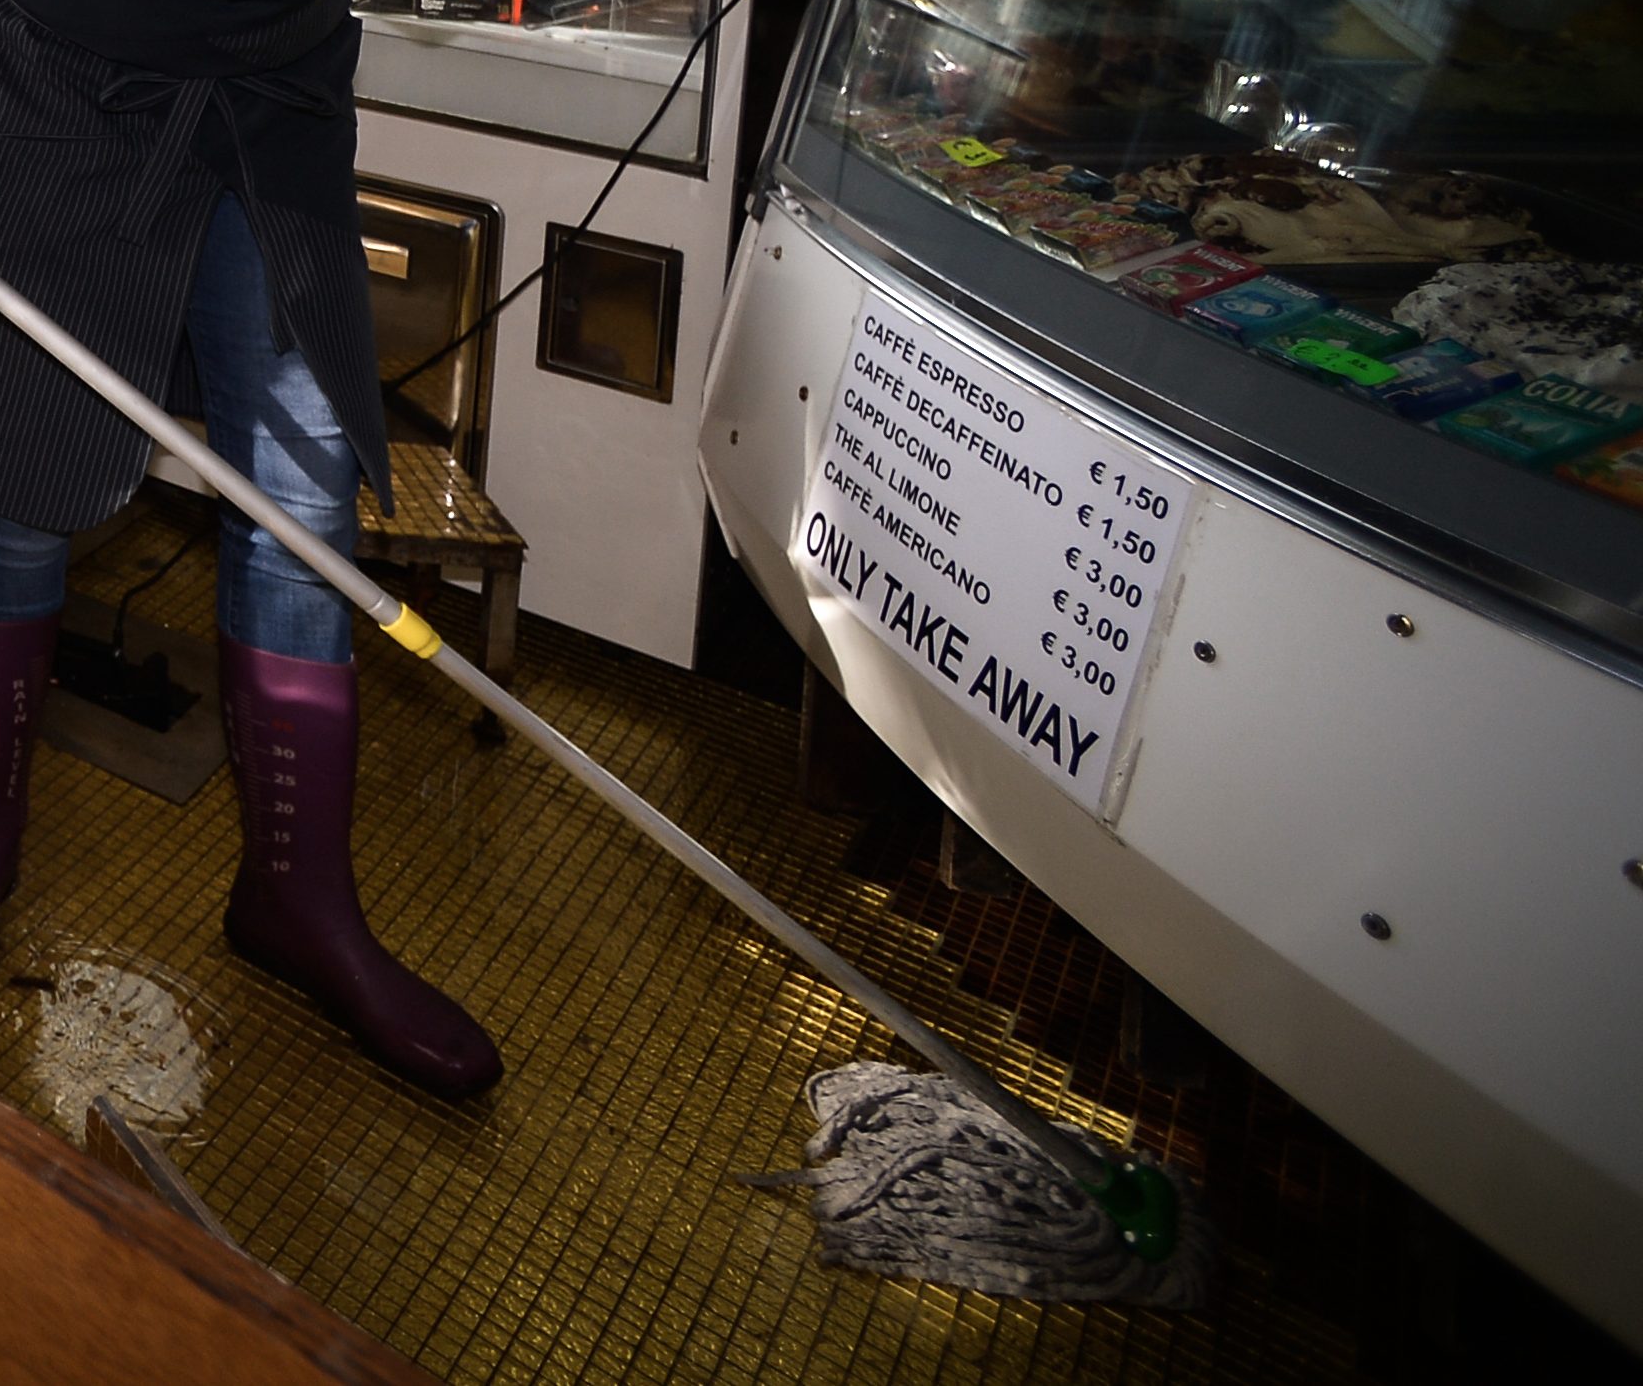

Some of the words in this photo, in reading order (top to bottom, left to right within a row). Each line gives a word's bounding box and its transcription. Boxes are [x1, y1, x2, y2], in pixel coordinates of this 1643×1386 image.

[854, 352, 904, 401] CAFFÈ
[906, 389, 1064, 507] DECAFFEINATO
[1077, 503, 1094, 527] €
[1101, 518, 1156, 565] 1,50
[864, 315, 916, 364] CAFFÈ
[917, 352, 1025, 434] ESPRESSO
[1089, 460, 1106, 484] €
[1113, 473, 1170, 520] 1,50
[833, 422, 862, 461] THE
[862, 448, 885, 481] AL
[888, 462, 961, 538] LIMONE
[1053, 588, 1069, 613] €
[1074, 601, 1130, 653] 3,00
[843, 388, 952, 482] CAPPUCCINO
[1065, 546, 1081, 570] €
[1086, 558, 1143, 609] 3,00
[824, 461, 873, 514] CAFFÈ
[873, 503, 991, 606] AMERICANO
[1041, 631, 1057, 656] €
[1061, 643, 1116, 697] 3,00
[13, 679, 26, 723] RAIN
[806, 510, 878, 602] ONLY
[877, 571, 970, 685] TAKE
[968, 654, 1100, 778] AWAY
[272, 744, 296, 760] 30
[274, 772, 296, 787] 25
[274, 801, 295, 815] 20
[272, 860, 291, 872] 10
[273, 831, 291, 844] 15
